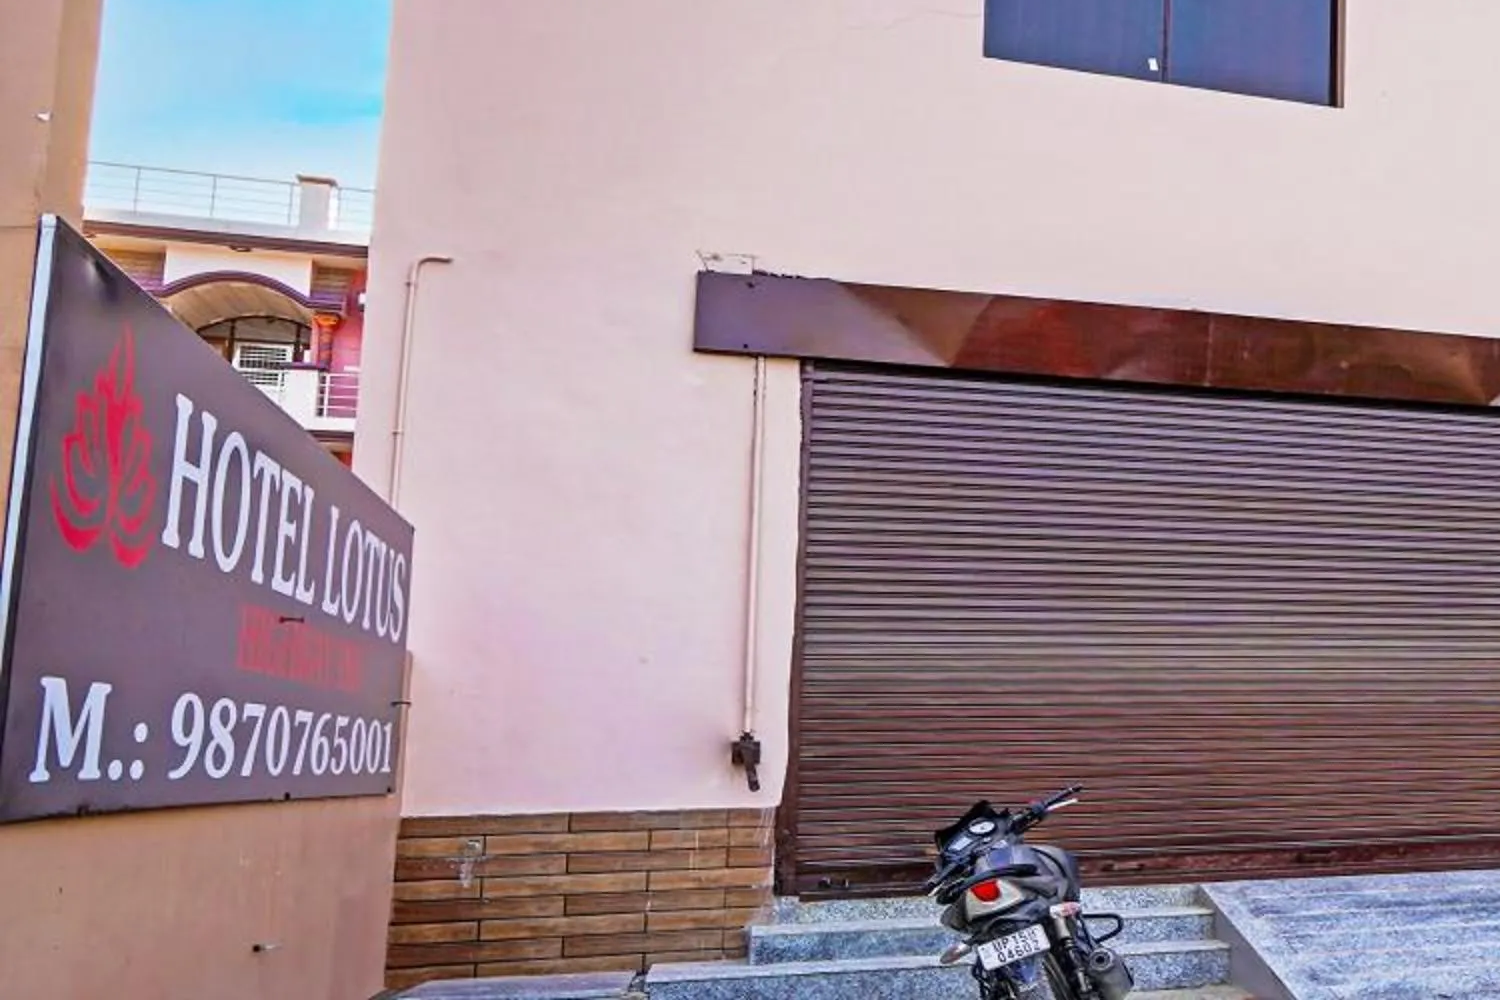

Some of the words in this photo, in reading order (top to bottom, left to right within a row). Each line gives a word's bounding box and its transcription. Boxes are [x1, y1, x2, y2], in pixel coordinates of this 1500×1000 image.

[161, 393, 316, 605] HOTEL
[321, 506, 408, 643] LOTUS
[28, 677, 148, 783] M.:
[167, 693, 392, 781] 9870765001
